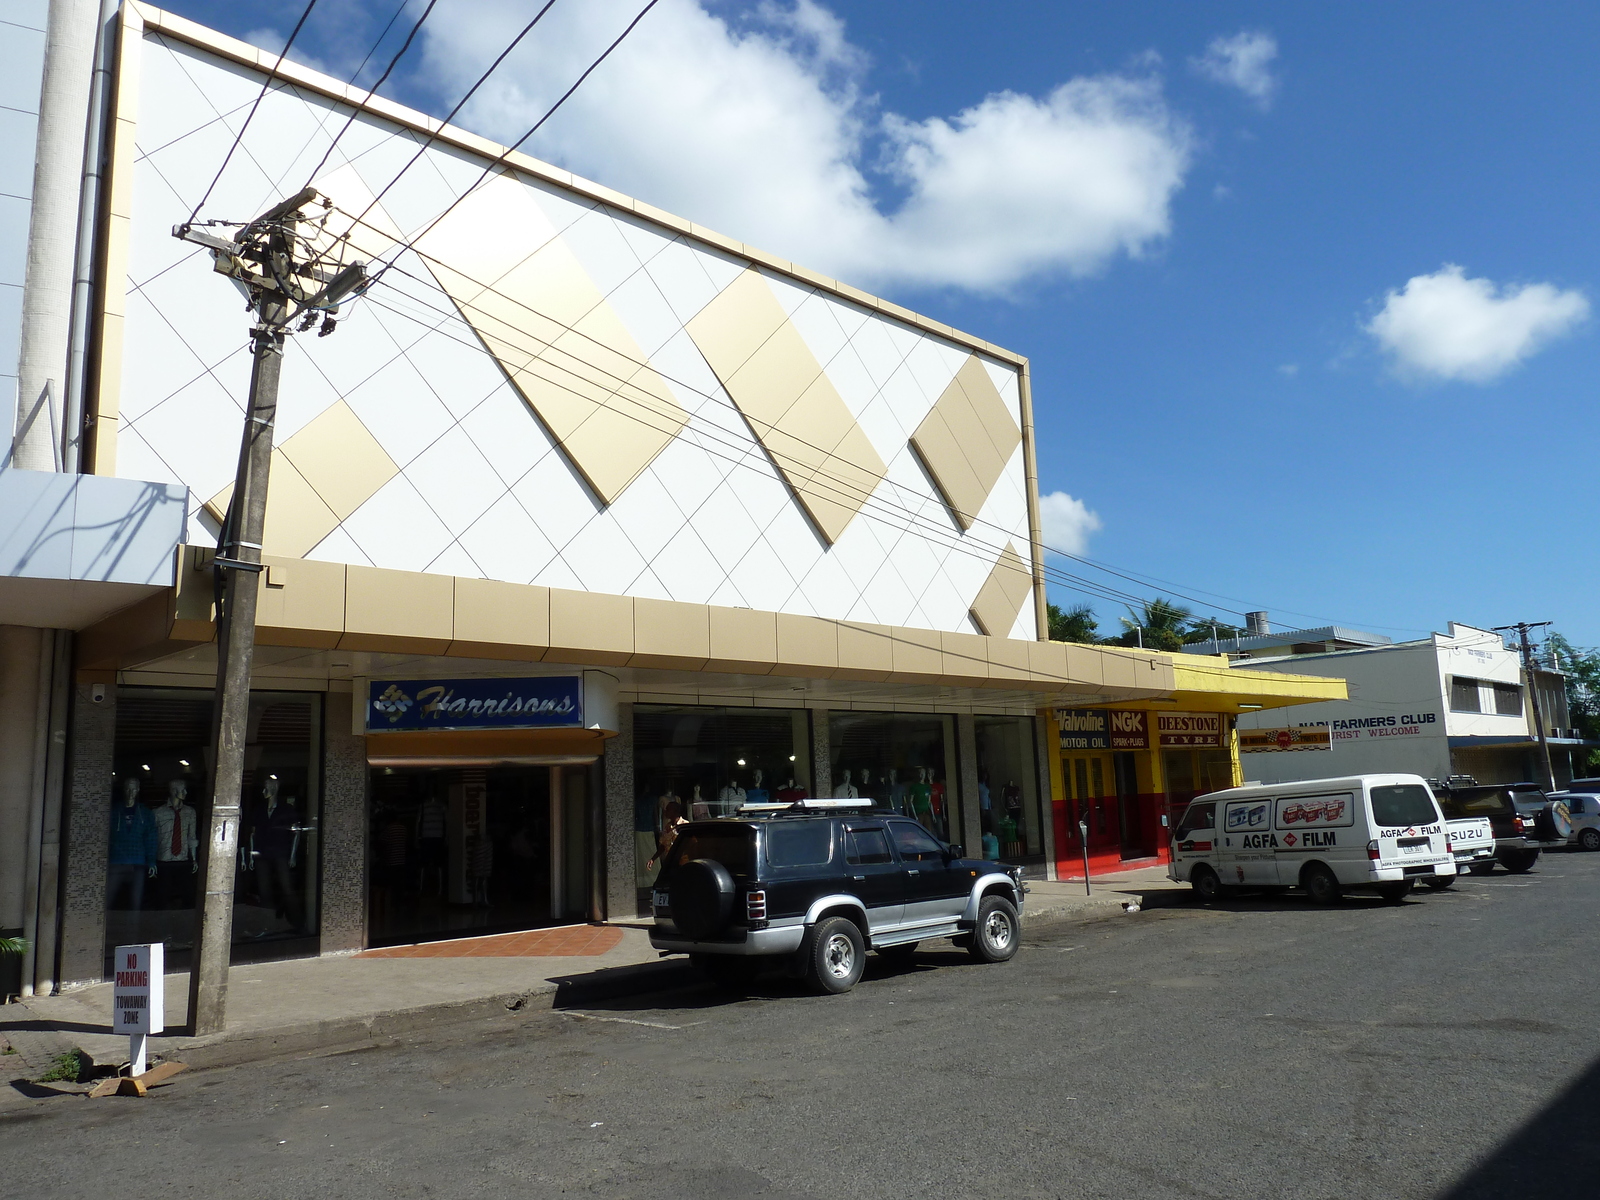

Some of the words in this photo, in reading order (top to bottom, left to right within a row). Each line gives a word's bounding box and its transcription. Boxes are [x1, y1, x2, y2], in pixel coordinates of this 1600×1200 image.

[416, 685, 575, 719] Harrisons
[1059, 710, 1105, 731] Valvoline
[1111, 711, 1143, 732] NGK
[1158, 716, 1218, 731] DEESTONE
[1333, 716, 1396, 730] FARMERS
[1401, 713, 1436, 725] CLUB
[1368, 726, 1420, 737] WELCOME
[1060, 737, 1088, 748] MOTOR
[1091, 737, 1106, 748] OIL
[1168, 736, 1216, 744] TYRE
[1380, 829, 1402, 838] AGFA
[1420, 826, 1441, 835] FILM
[1243, 833, 1279, 848] AGFA
[1302, 832, 1336, 847] FILM
[127, 953, 137, 970] NO
[117, 971, 148, 987] PARKING
[116, 995, 148, 1009] TOWAWAY
[123, 1011, 139, 1024] ZONE
